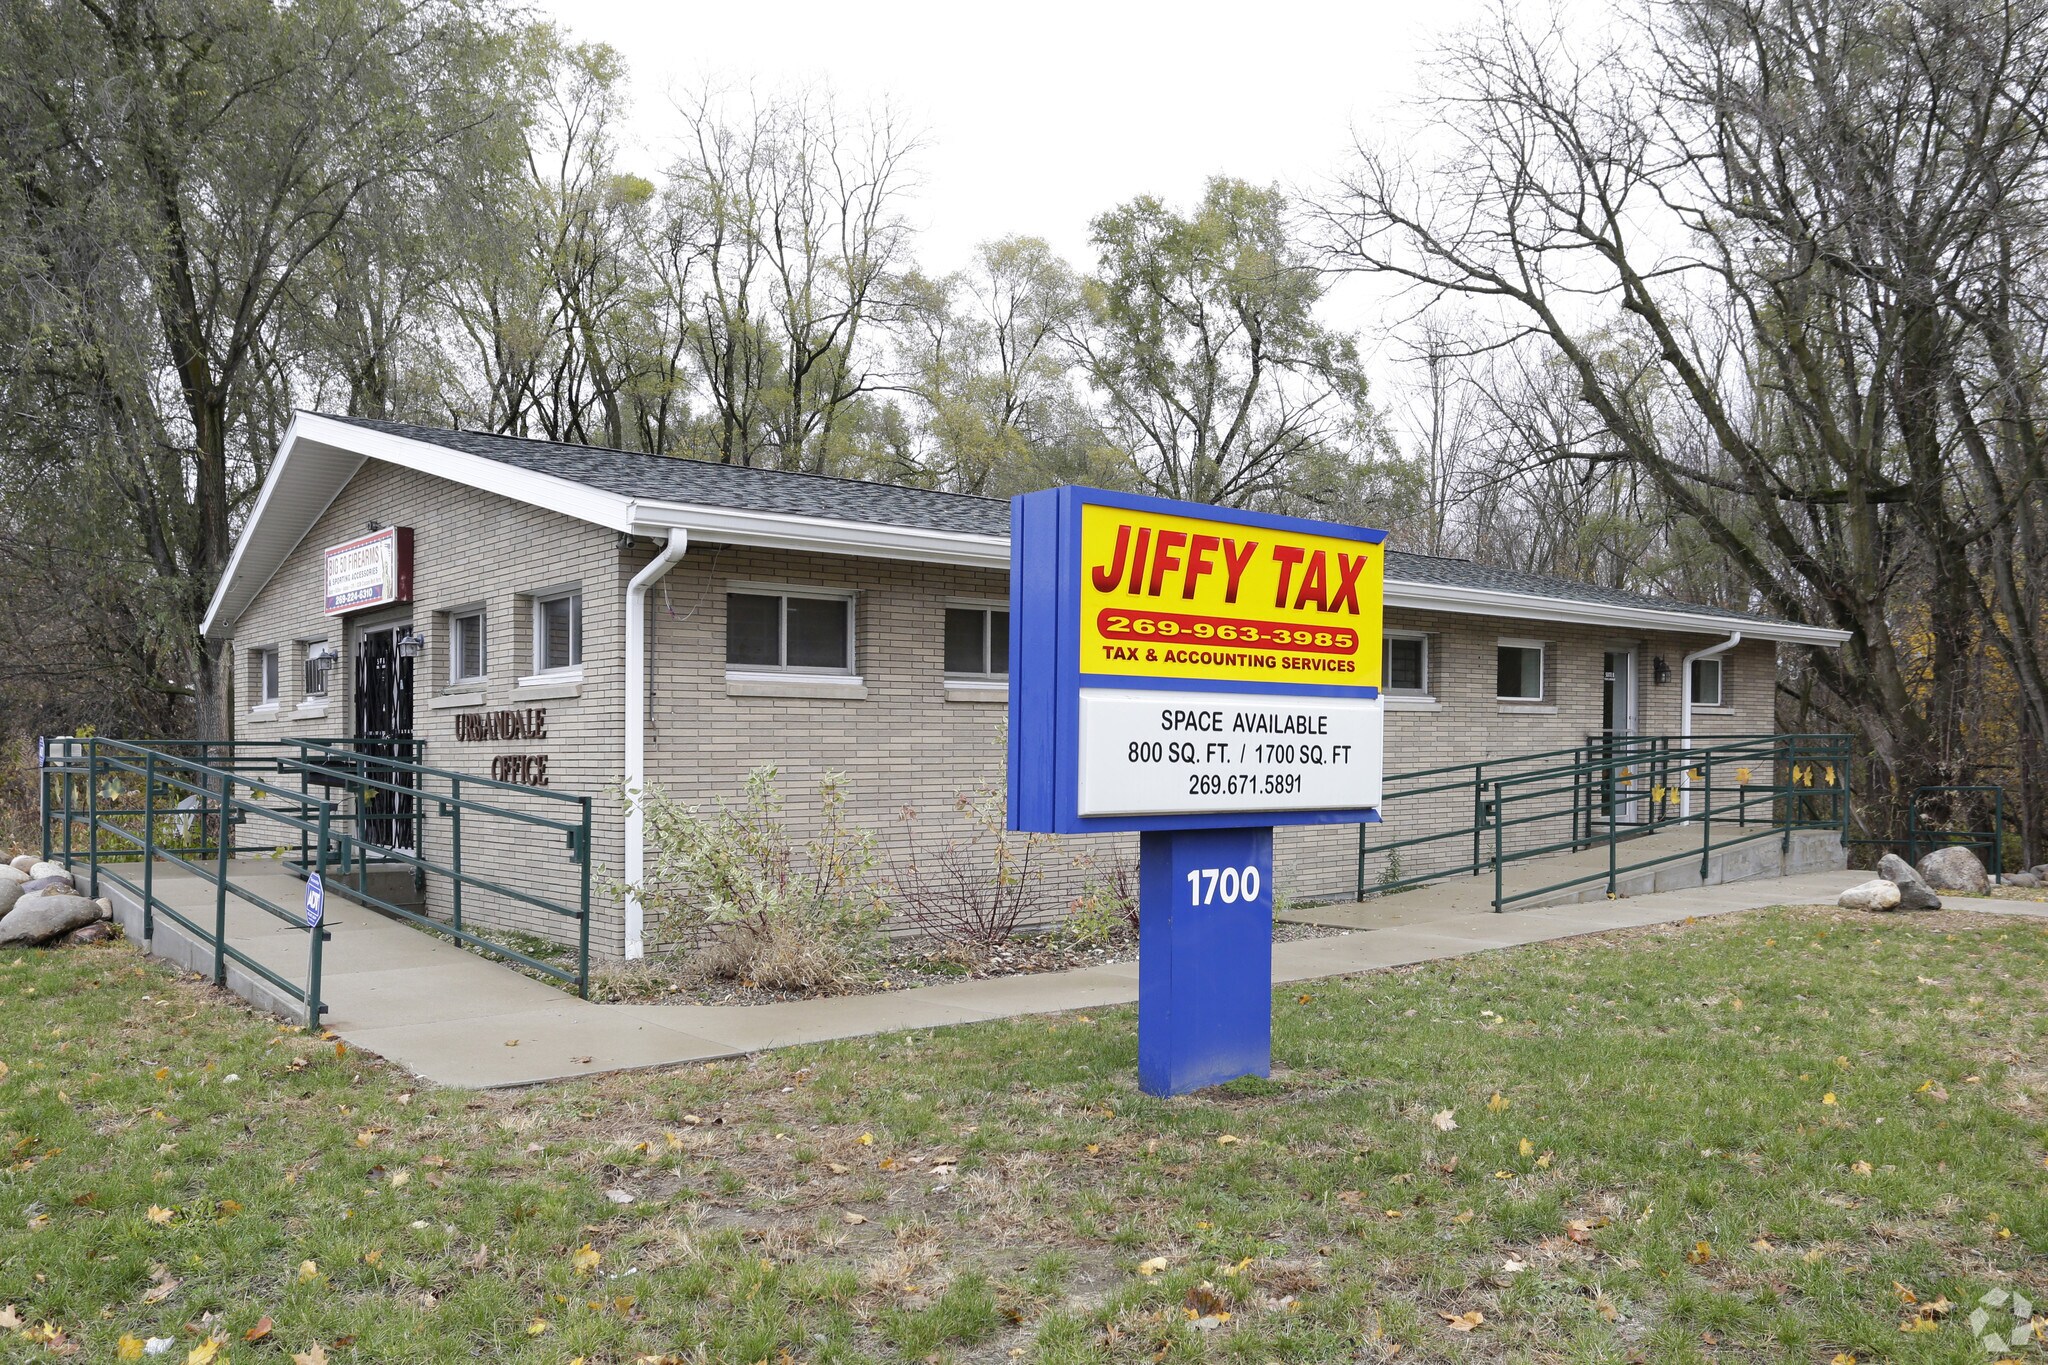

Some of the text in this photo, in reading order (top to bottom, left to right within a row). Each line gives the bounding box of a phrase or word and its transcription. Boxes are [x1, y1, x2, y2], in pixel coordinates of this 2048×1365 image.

[328, 558, 339, 577] BIG
[348, 545, 380, 571] FIREARMS
[1091, 524, 1369, 616] JIFFY TAX
[332, 574, 351, 586] SPORTING
[351, 566, 379, 581] ACCESSORIES
[335, 587, 373, 605] 269-224-6310
[1106, 616, 1354, 648] 269-963-3985
[1102, 645, 1356, 673] TAX & ACCOUNTING SERVICES
[455, 708, 547, 742] URBANDALE
[1161, 709, 1328, 735] SPACE AVAILABLE
[1128, 741, 1352, 766] 800 SQ. FT. / 1700 SQ. FT
[492, 755, 548, 786] OFFICE
[1189, 773, 1301, 795] 269.671.5891
[1187, 865, 1260, 906] 1700
[307, 890, 320, 911] ADT
